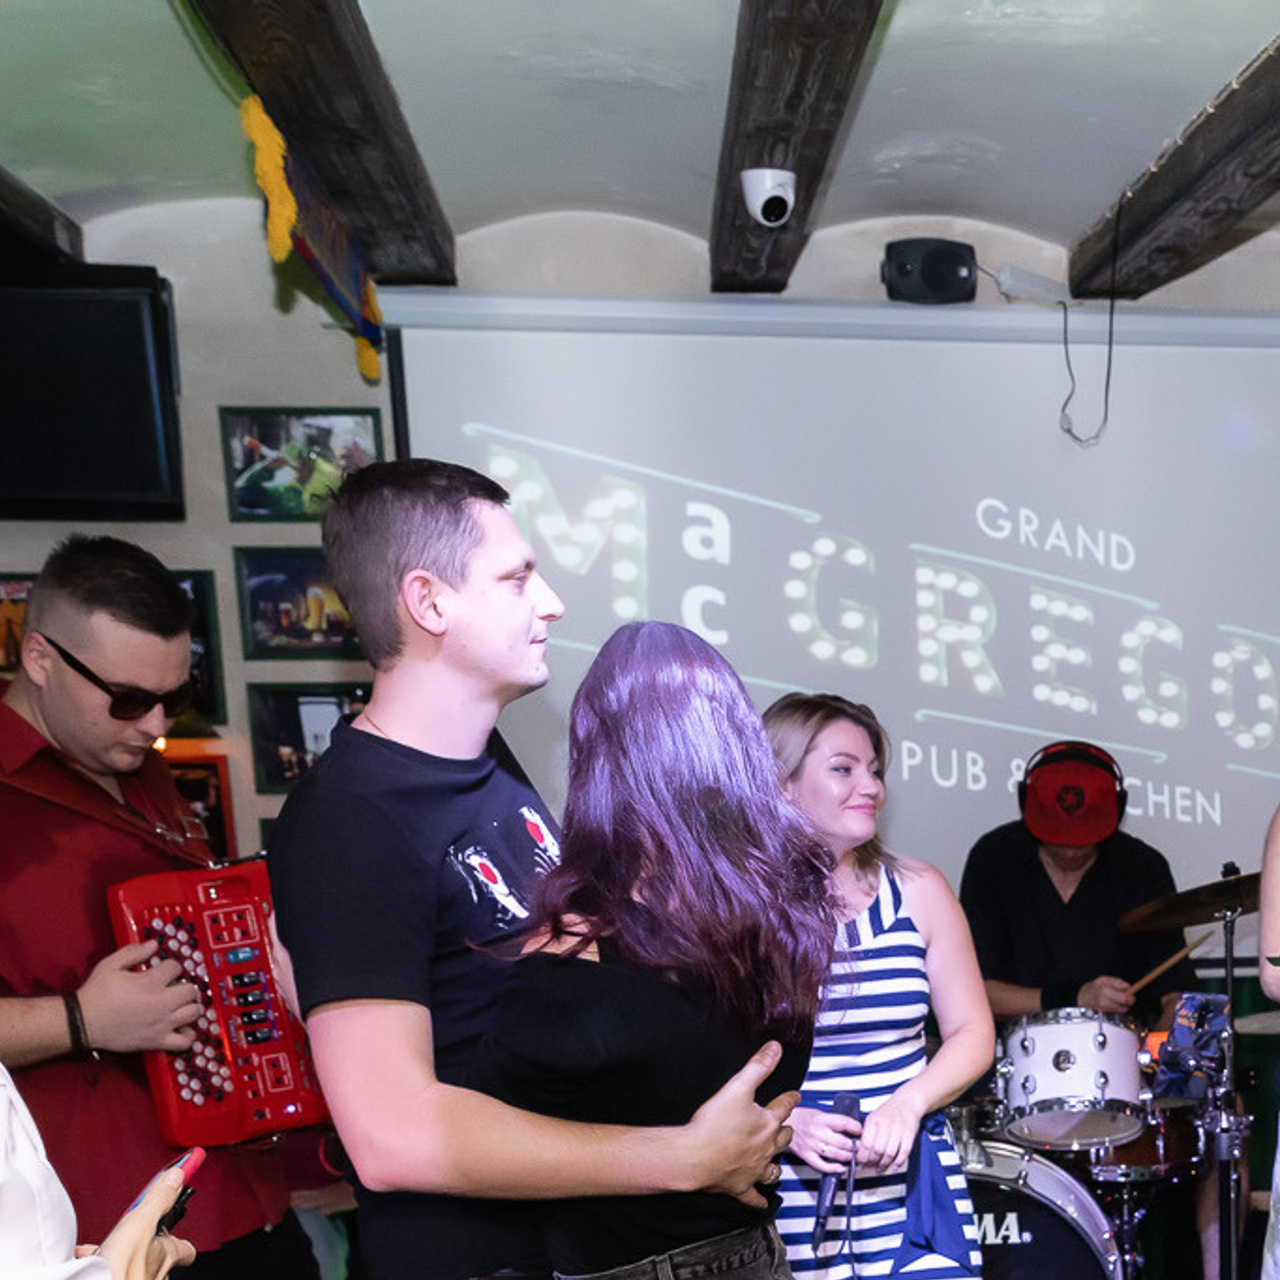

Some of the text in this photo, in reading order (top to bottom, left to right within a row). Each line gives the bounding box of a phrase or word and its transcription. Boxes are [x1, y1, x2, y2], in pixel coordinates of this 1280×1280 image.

[975, 497, 1136, 572] GRAND
[900, 739, 988, 791] PUB
[1123, 776, 1221, 826] CHEN
